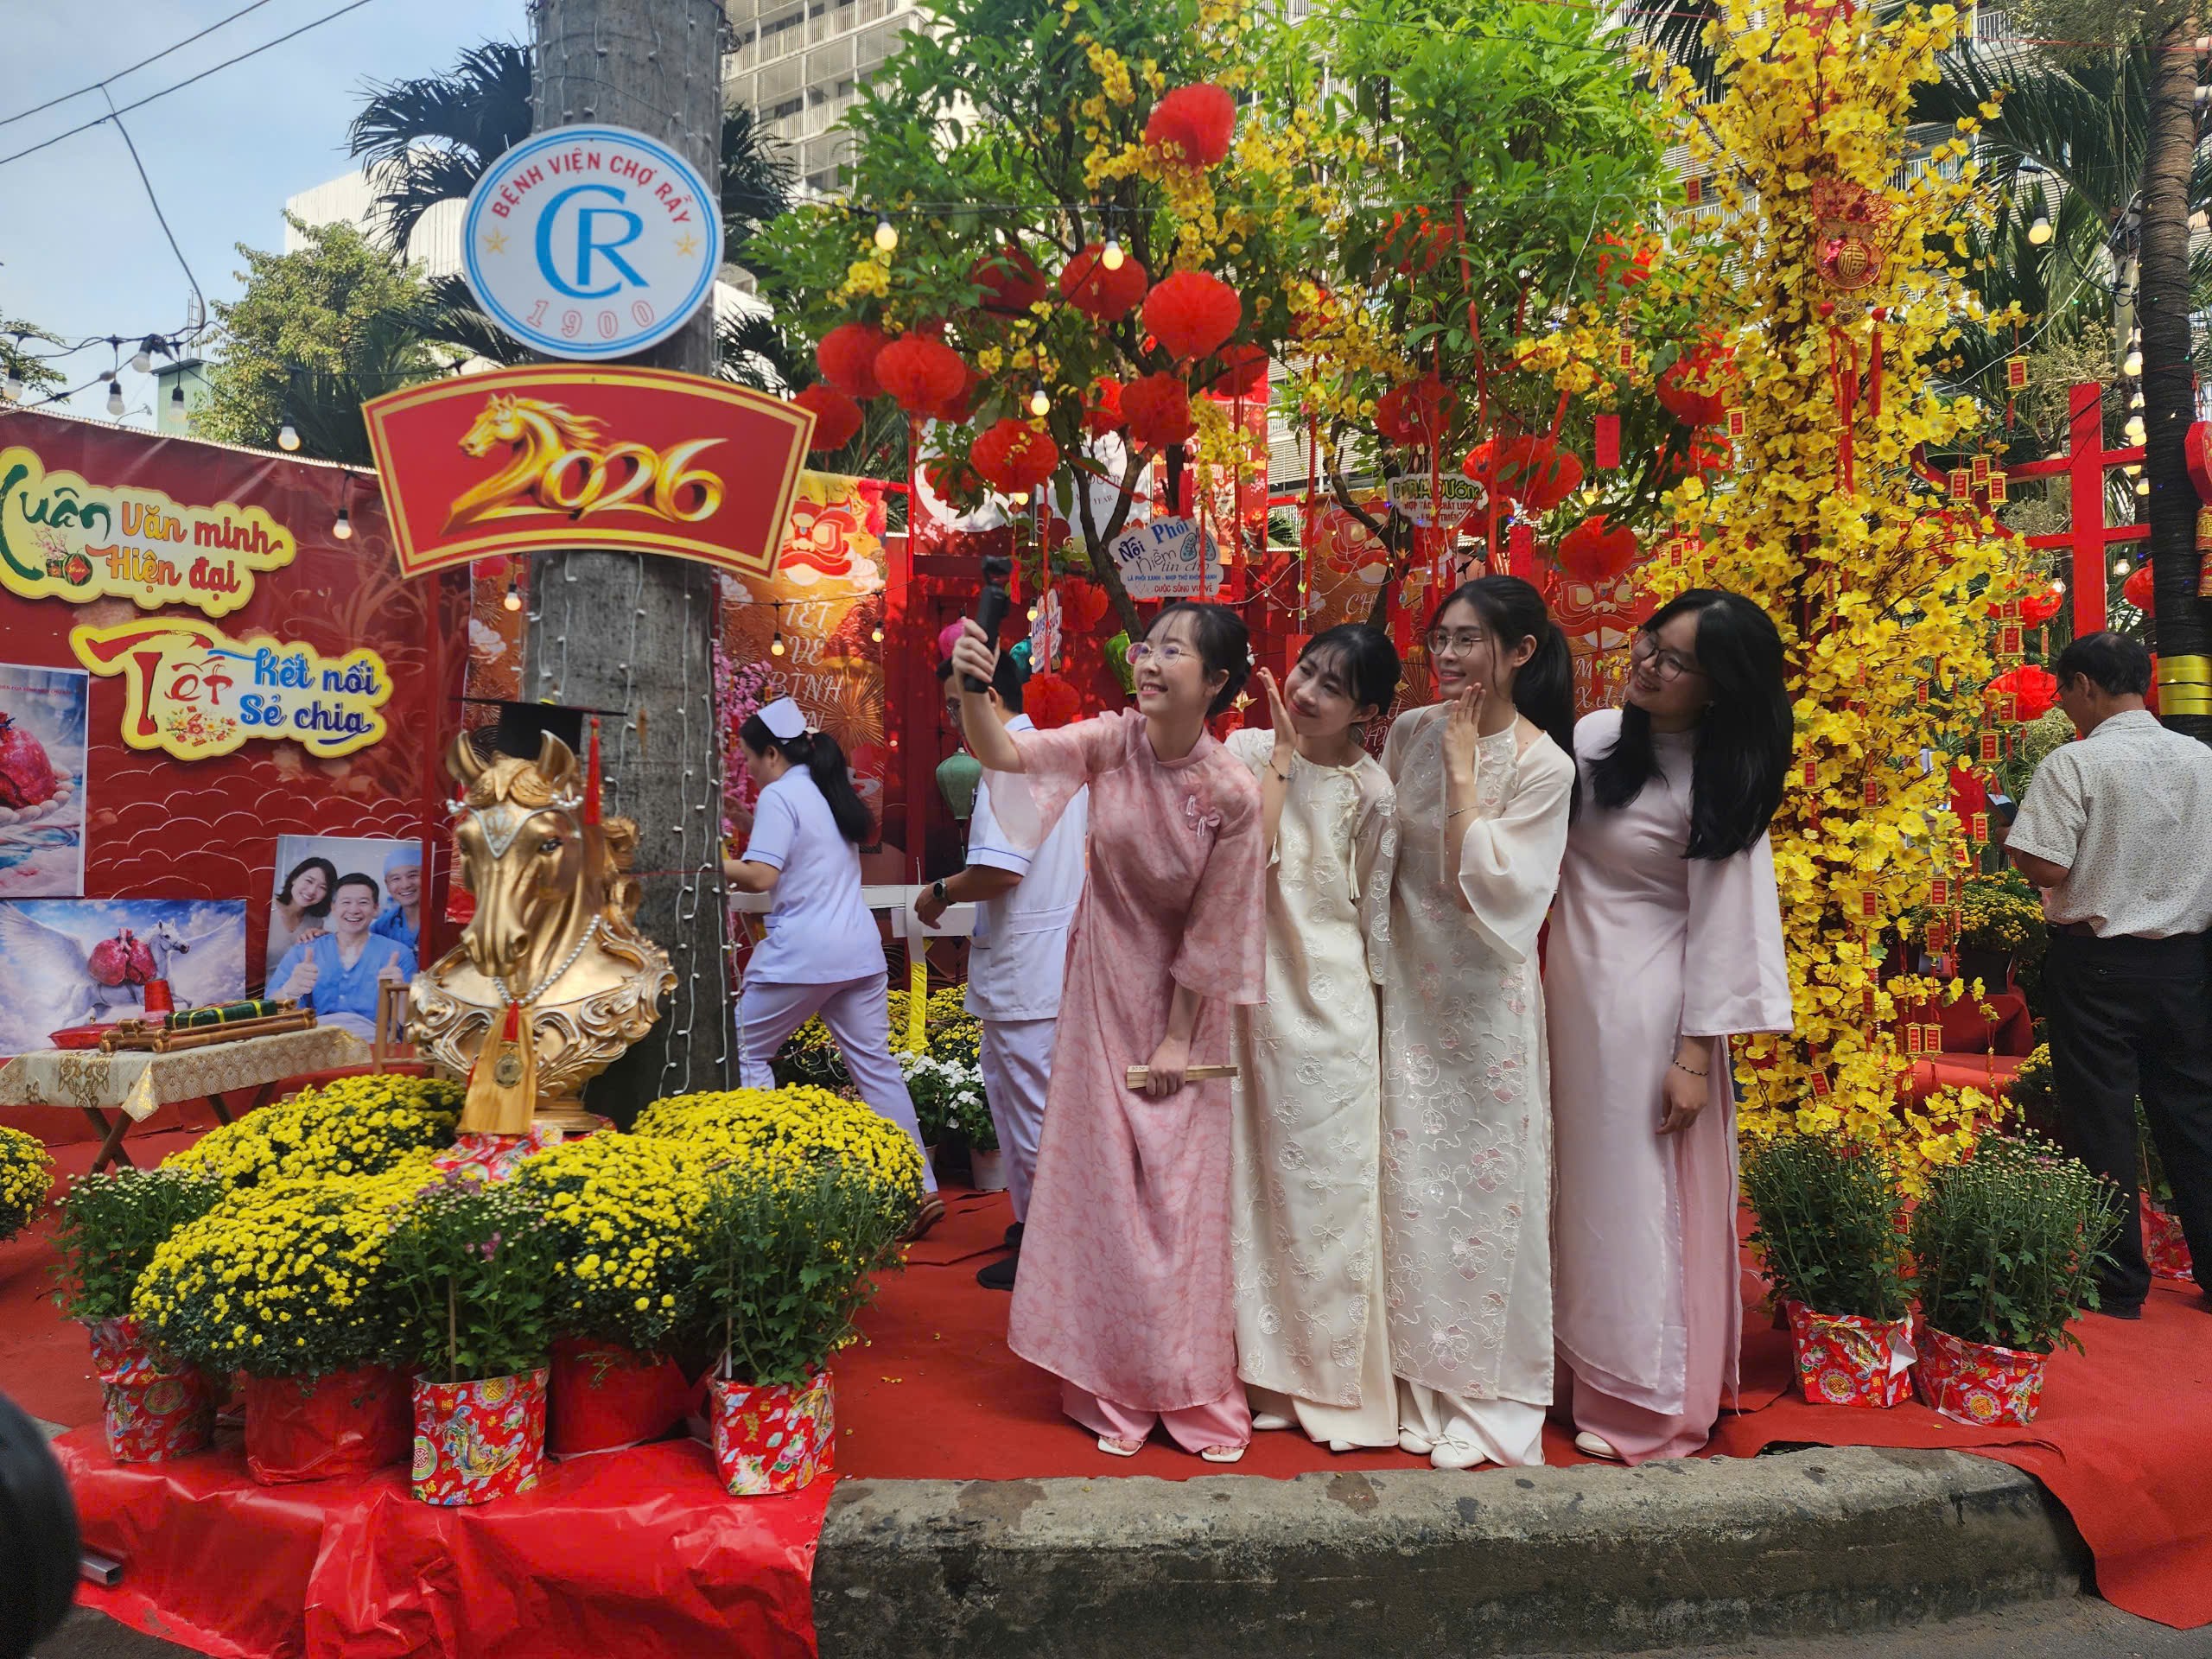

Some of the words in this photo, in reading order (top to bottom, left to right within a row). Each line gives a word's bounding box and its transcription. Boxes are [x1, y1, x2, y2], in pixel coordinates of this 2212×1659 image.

[492, 165, 544, 219] BỆNH
[548, 147, 601, 175] VIỆN
[609, 155, 658, 188] CHỢ
[654, 182, 694, 224] RẪY
[526, 299, 655, 340] 1900
[441, 393, 729, 536] 2026
[121, 500, 188, 543] Văn
[194, 516, 283, 555] minh
[1118, 536, 1146, 563] Nội
[86, 544, 182, 594] Hiện
[188, 556, 241, 601] đại
[785, 594, 835, 630] TẾT
[788, 630, 828, 666] VỀ
[86, 629, 234, 736] Tết
[322, 658, 381, 696] nối
[771, 667, 843, 704] BÌNH
[239, 693, 288, 728] Sẻ
[294, 700, 375, 746] chia
